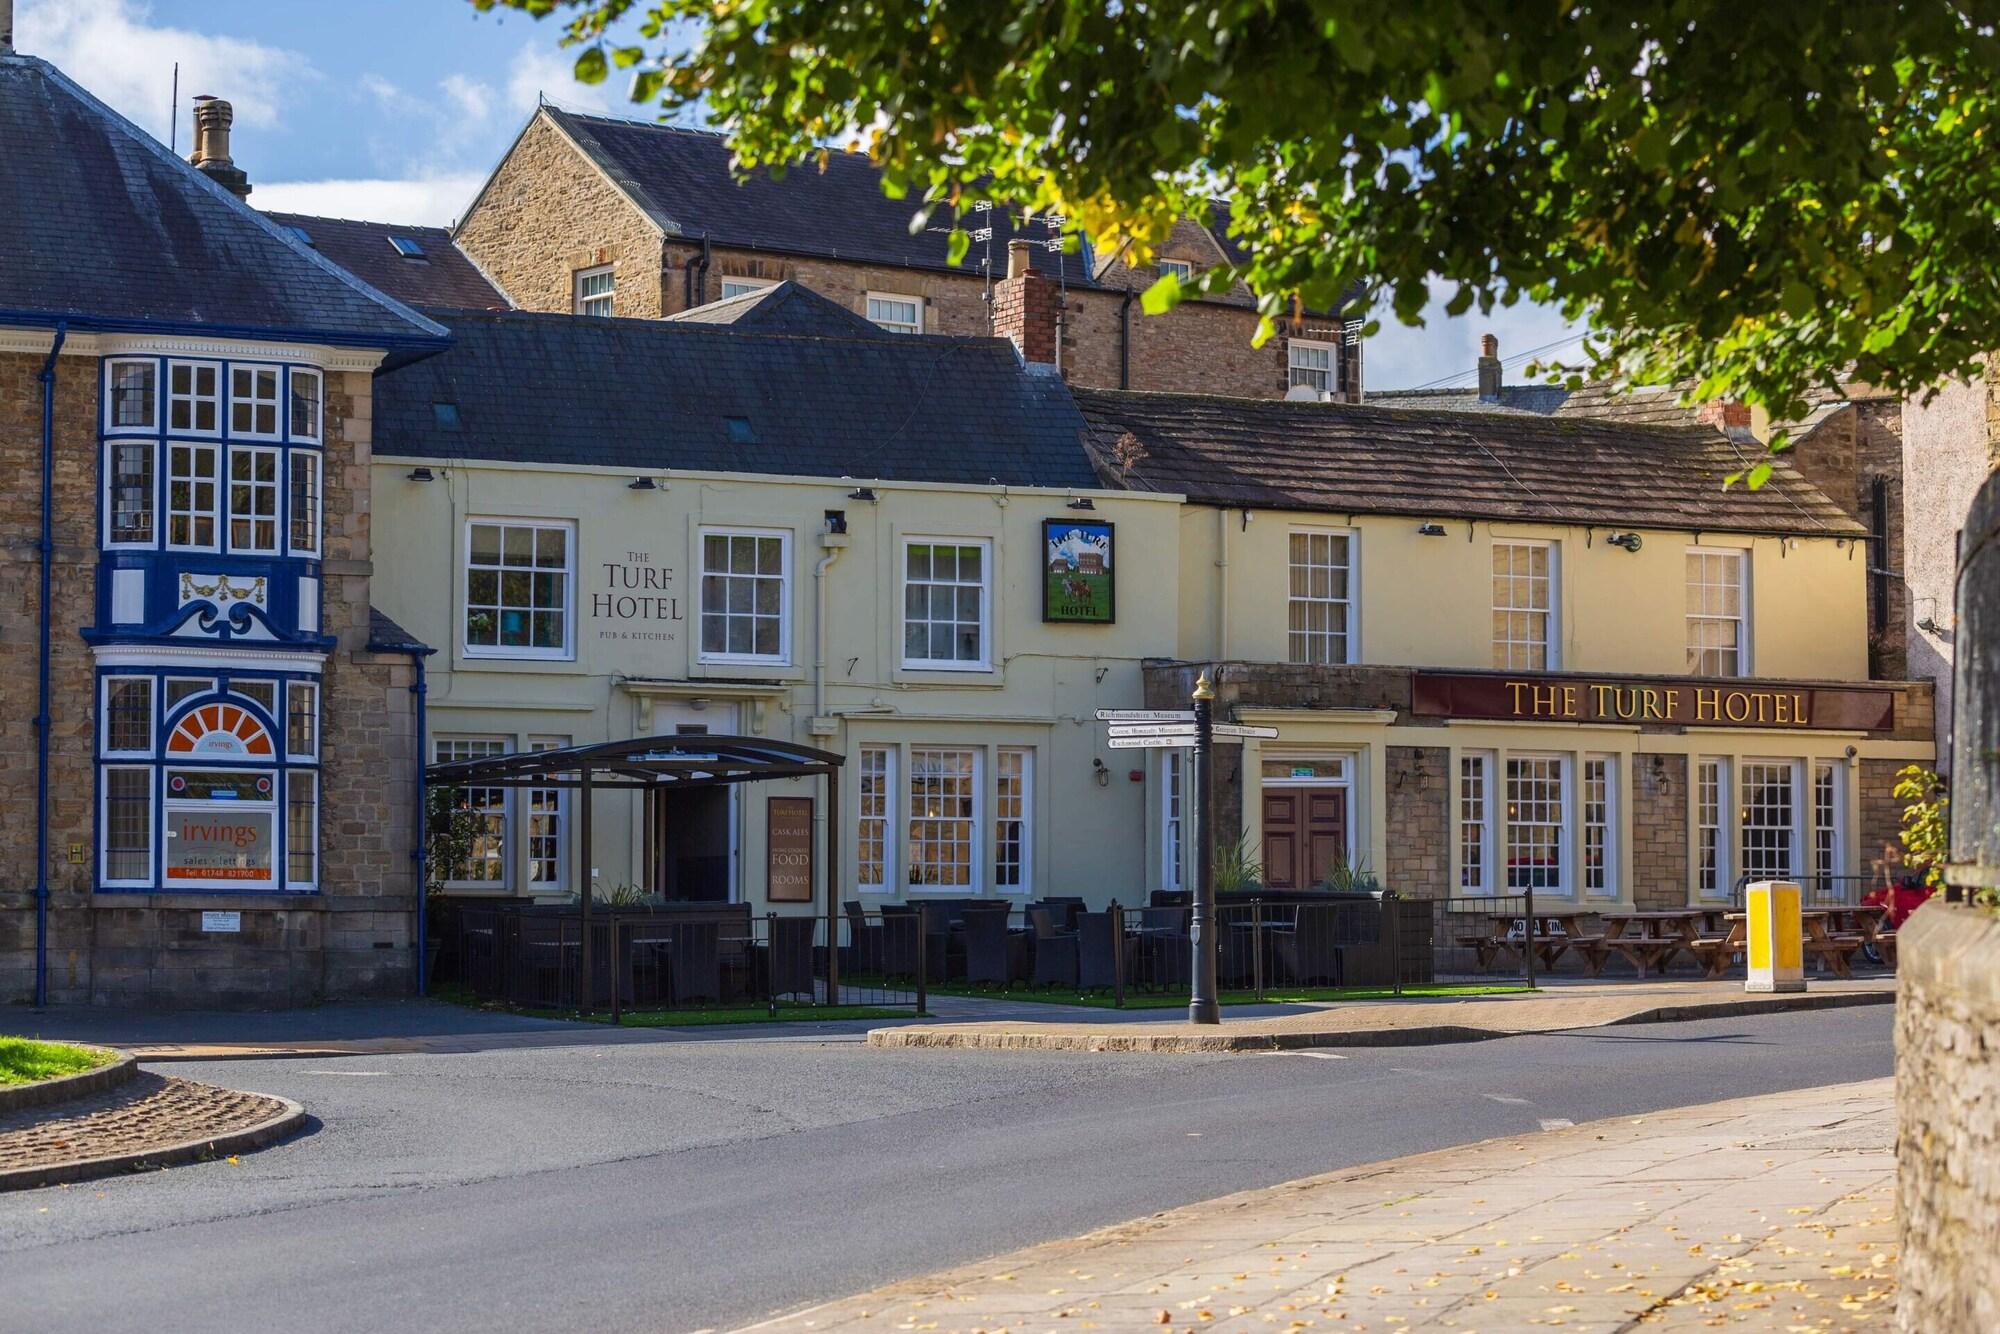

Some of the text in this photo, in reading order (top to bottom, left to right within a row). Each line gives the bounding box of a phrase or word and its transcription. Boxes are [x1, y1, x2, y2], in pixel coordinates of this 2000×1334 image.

[1051, 530, 1109, 549] THE TURF
[627, 552, 650, 563] THE
[603, 563, 673, 590] TURF
[592, 593, 683, 620] HOTEL
[1061, 606, 1097, 616] HOTEL
[599, 631, 675, 641] PUB & KITCHEN
[1505, 682, 1808, 725] THE TURF HOTEL
[1100, 711, 1181, 719] Richmondshire Museum
[208, 740, 233, 749] irvings
[183, 818, 257, 848] irvings
[772, 828, 809, 837] CASK ALES
[183, 853, 208, 865] sales
[772, 853, 809, 866] FOOD
[772, 875, 809, 885] ROOMS
